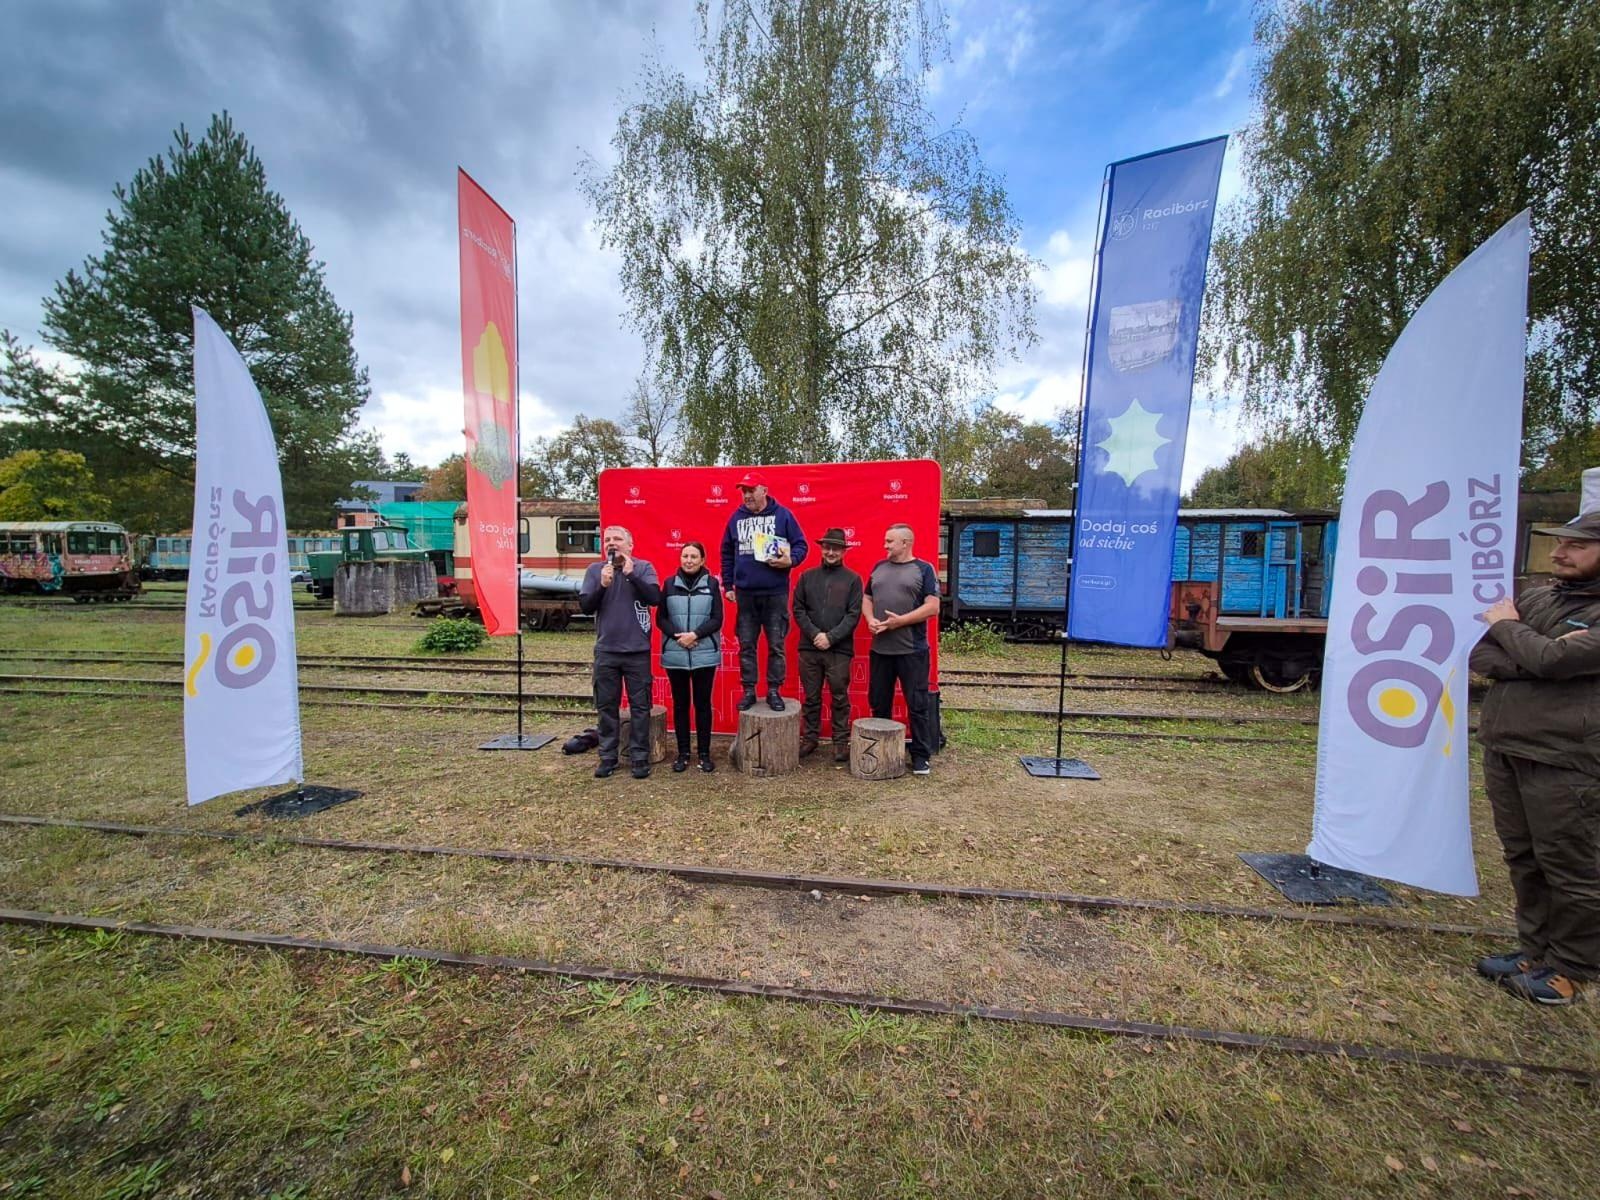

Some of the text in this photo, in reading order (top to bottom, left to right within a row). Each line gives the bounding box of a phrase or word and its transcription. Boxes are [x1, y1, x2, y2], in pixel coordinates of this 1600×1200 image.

[1143, 199, 1209, 220] Racibórz
[1079, 535, 1135, 550] od siebie
[1081, 519, 1158, 537] Dodaj coś
[1458, 473, 1506, 622] CIBÓRZ
[1347, 479, 1456, 749] OSiR
[745, 729, 767, 770] 1
[858, 734, 881, 775] 3
